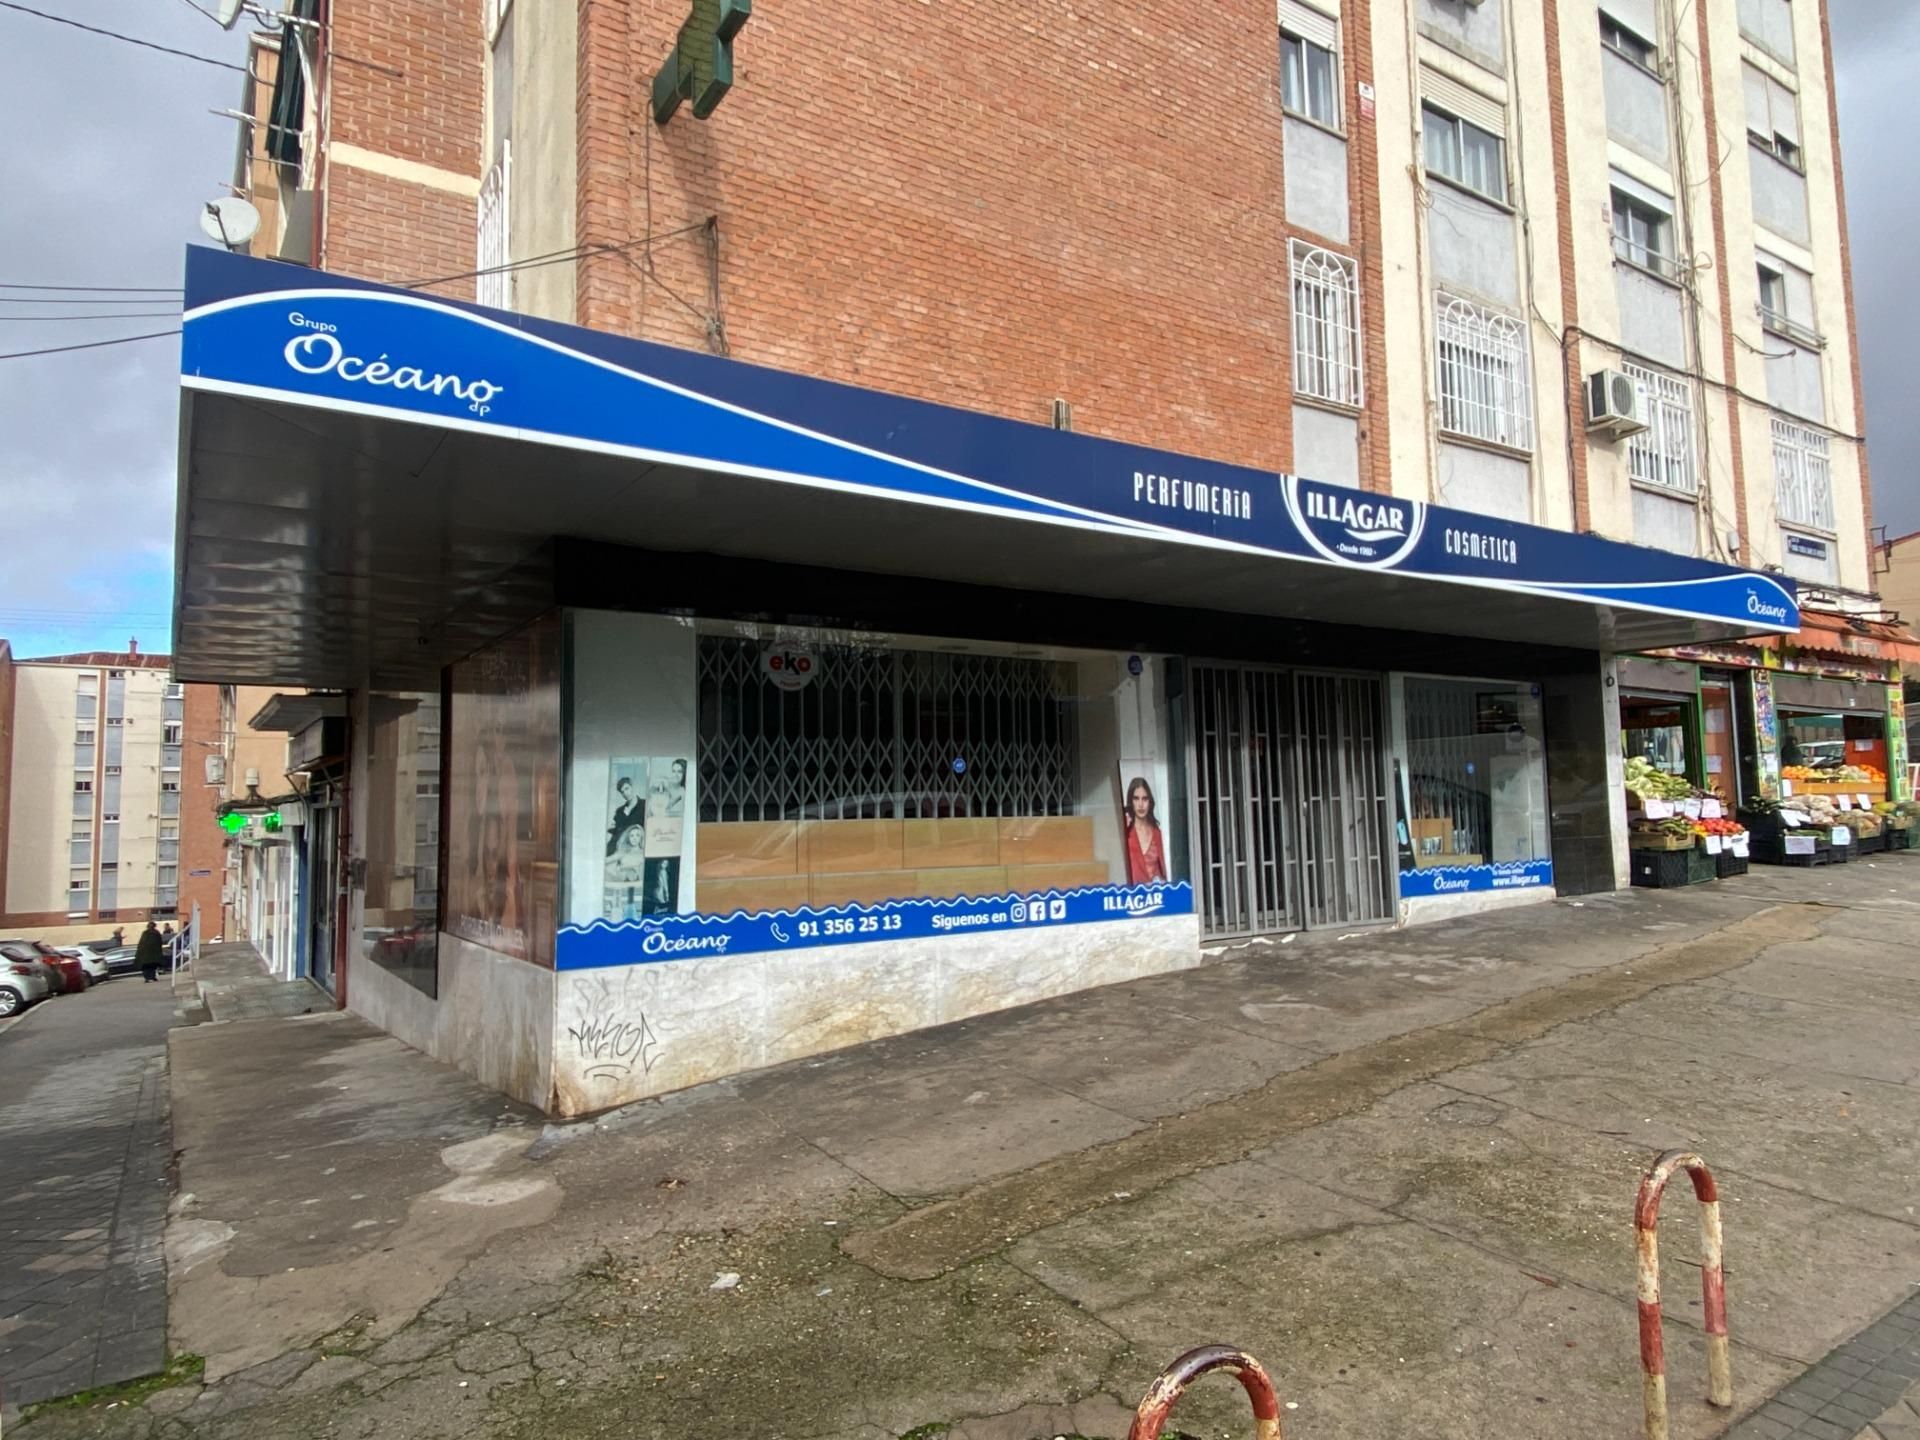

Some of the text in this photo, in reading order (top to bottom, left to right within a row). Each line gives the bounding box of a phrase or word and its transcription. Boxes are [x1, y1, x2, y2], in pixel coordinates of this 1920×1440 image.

[288, 311, 338, 333] Grupo
[284, 332, 504, 402] Océano
[1307, 491, 1404, 531] ILLAGAR
[769, 651, 812, 675] eko
[1103, 892, 1163, 911] ILLAGAR
[798, 914, 902, 937] 91 356 25 13
[991, 912, 1007, 923] en
[642, 931, 732, 954] Océano
